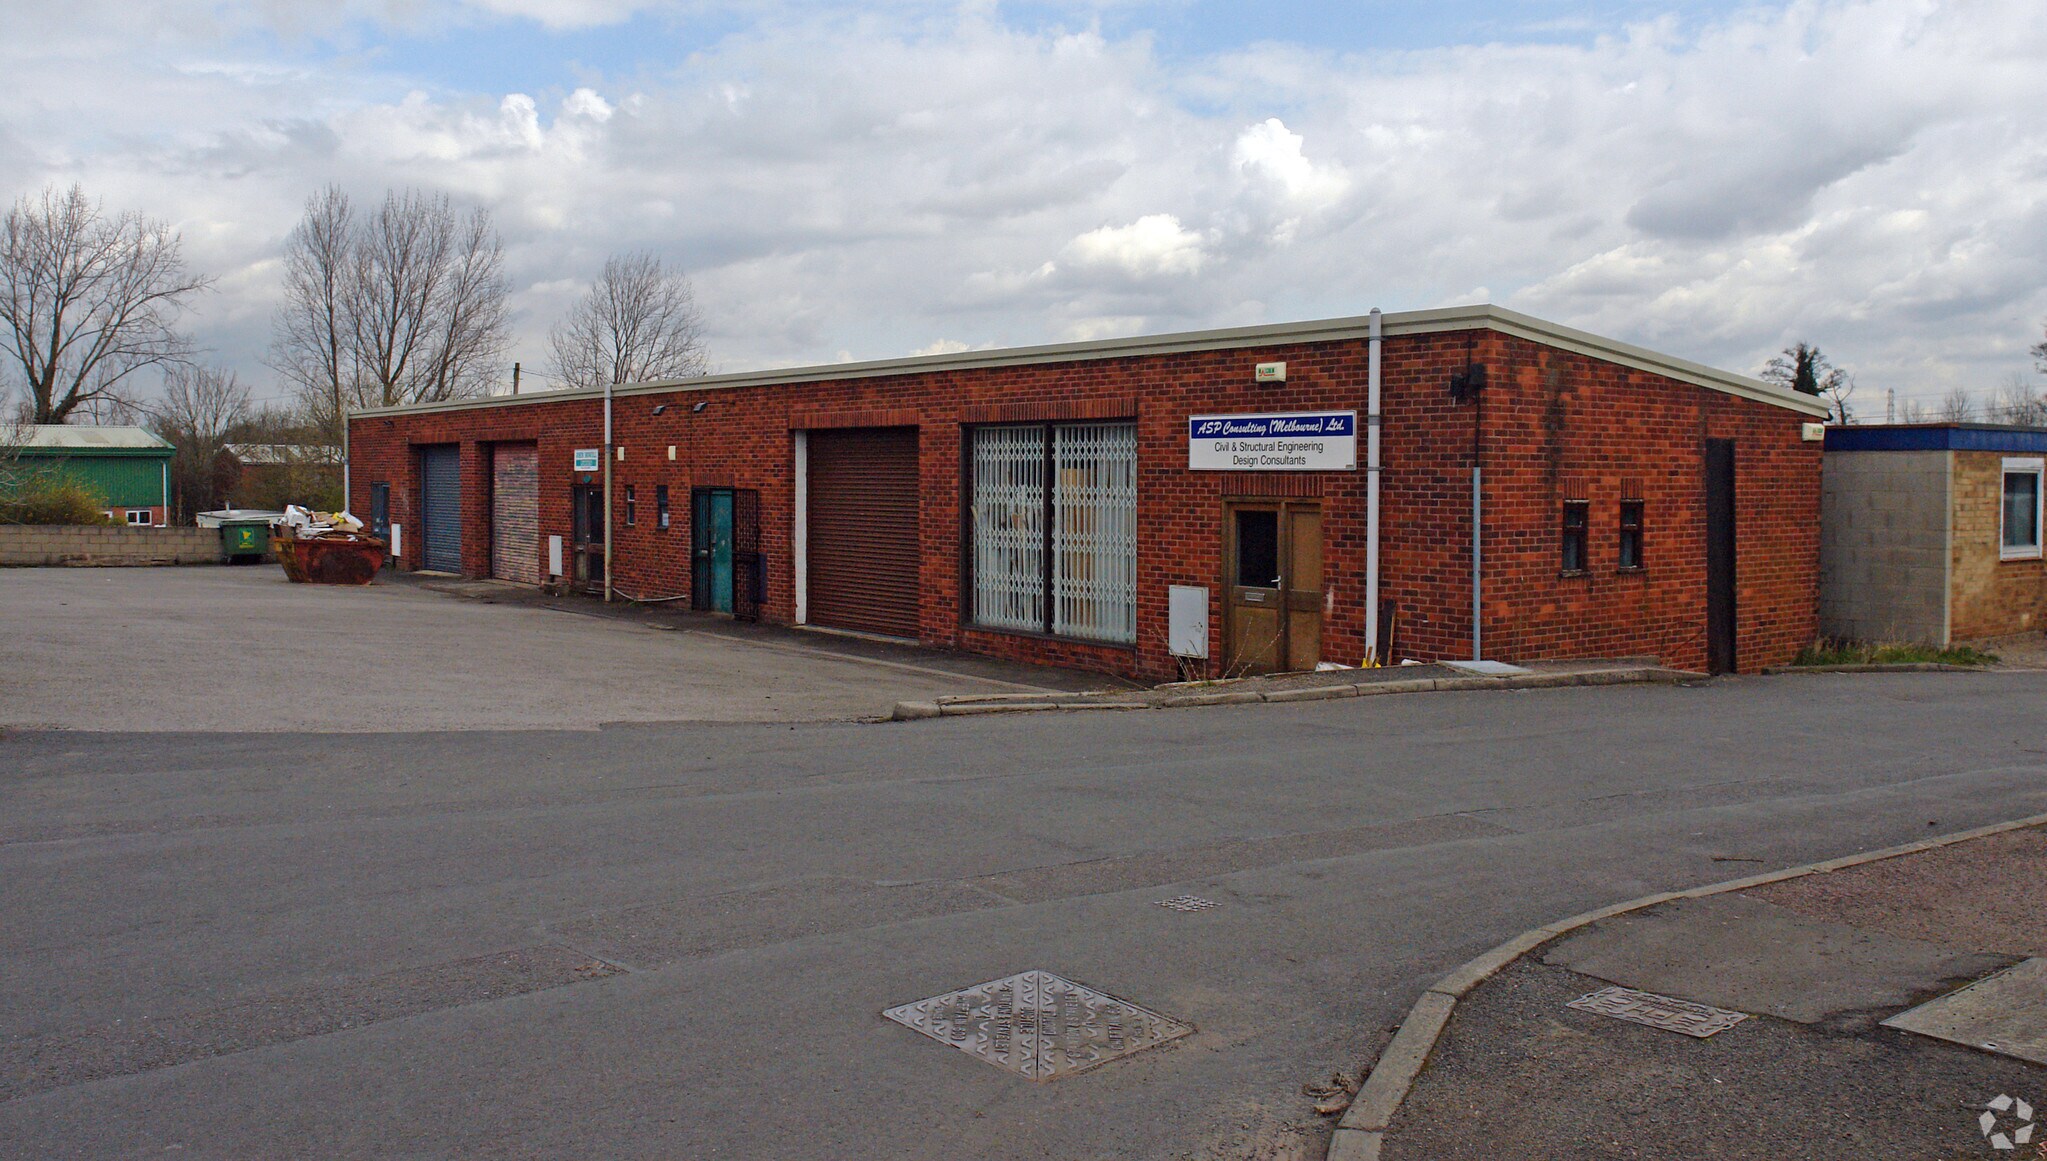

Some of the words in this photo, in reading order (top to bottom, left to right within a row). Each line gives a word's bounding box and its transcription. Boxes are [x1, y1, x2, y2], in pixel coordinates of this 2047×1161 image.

[1197, 421, 1222, 434] ASP
[1223, 421, 1266, 435] Consulting
[1269, 418, 1323, 434] (Melbourne)
[1325, 418, 1344, 431] Ltd.
[1215, 442, 1229, 452] Civil
[1232, 442, 1237, 452] &
[1240, 441, 1276, 452] Structural
[1278, 441, 1323, 453] Engineering
[1233, 455, 1258, 467] Design
[1261, 455, 1306, 465] Consultants
